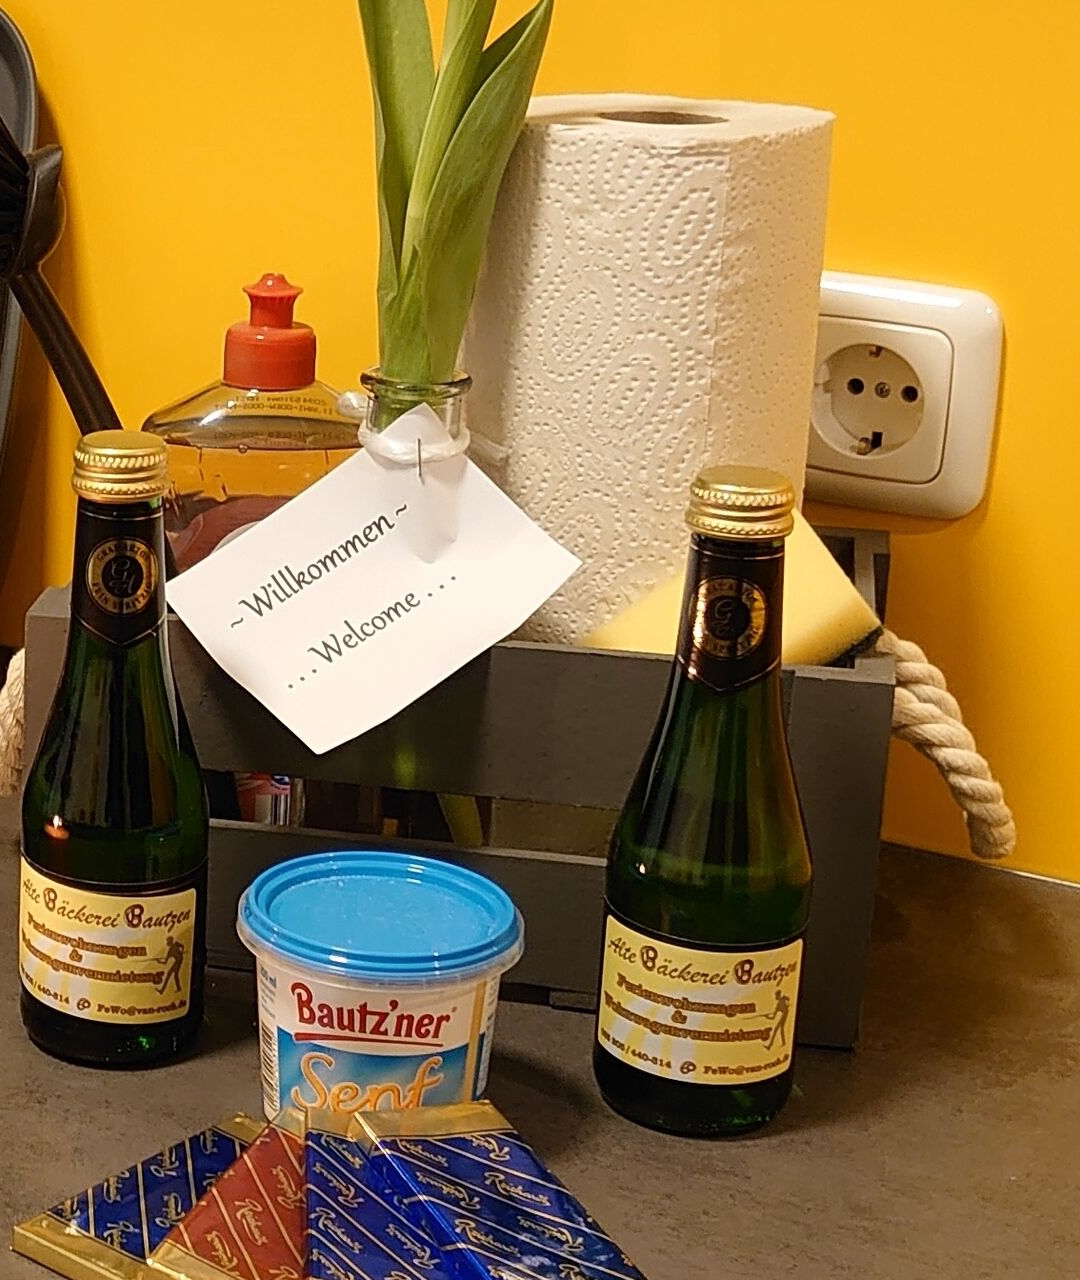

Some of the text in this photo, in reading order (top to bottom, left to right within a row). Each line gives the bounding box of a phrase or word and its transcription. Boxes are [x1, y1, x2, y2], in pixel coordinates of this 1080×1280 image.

[307, 593, 422, 664] Welcome
[22, 878, 192, 932] Alte Bäckerei Bautzen
[69, 949, 83, 963] &
[607, 937, 637, 964] Alte
[640, 945, 730, 986] Bäckerei
[290, 982, 451, 1039] Bautz'ner
[671, 1009, 688, 1025] &
[291, 1052, 444, 1111] Senf
